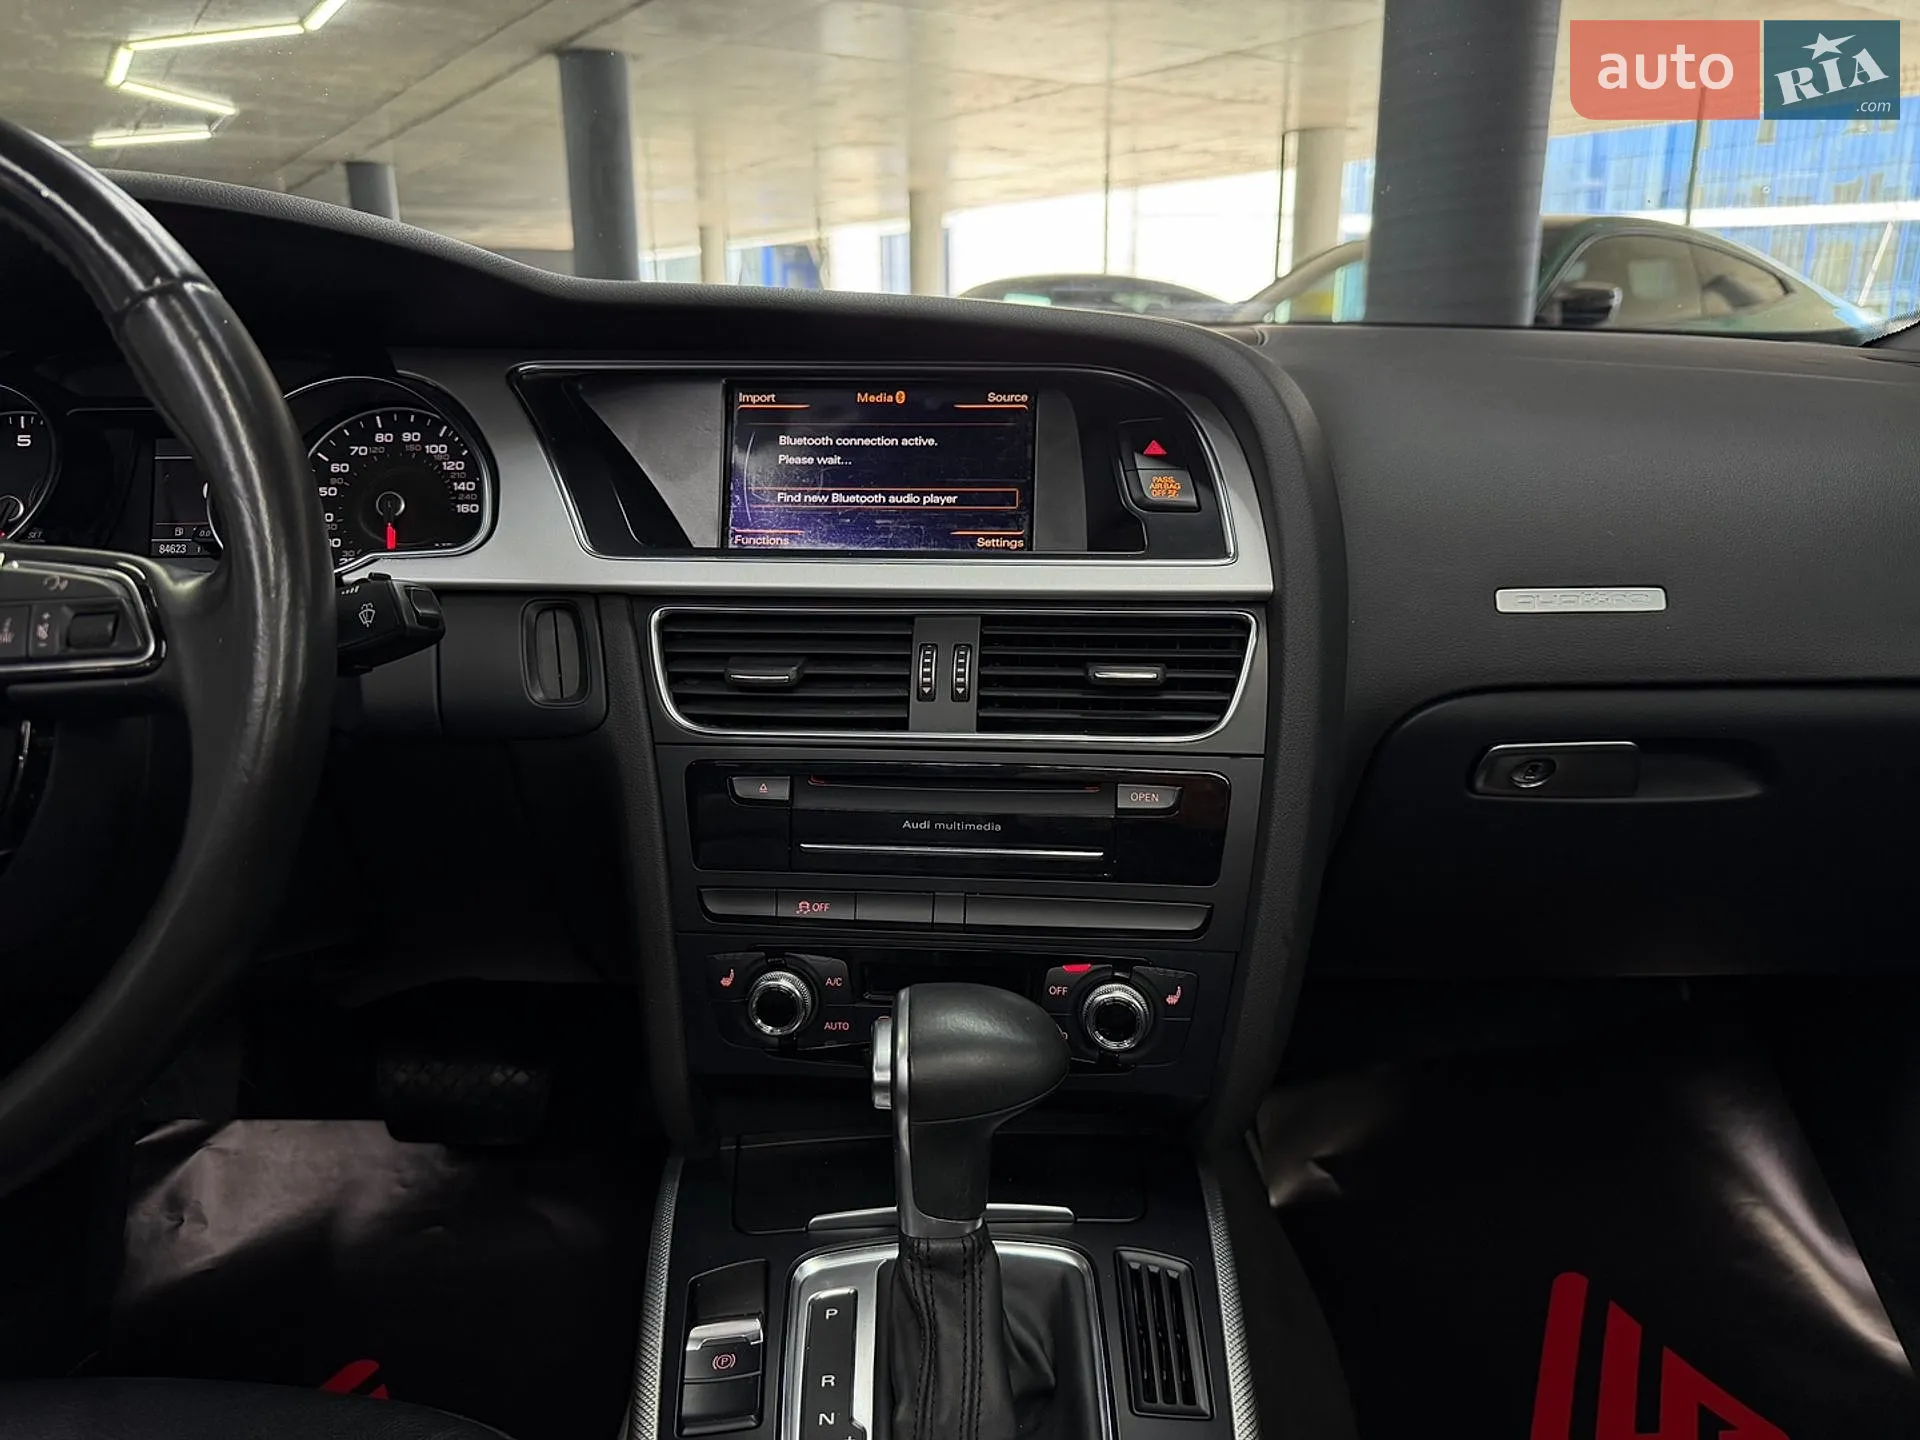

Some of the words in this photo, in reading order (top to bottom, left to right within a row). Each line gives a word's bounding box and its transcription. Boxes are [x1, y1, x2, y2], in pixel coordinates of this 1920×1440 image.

[738, 392, 776, 404] Import
[856, 393, 894, 403] Media
[987, 392, 1028, 402] Source
[16, 434, 31, 447] 5
[375, 433, 393, 443] 80
[402, 432, 421, 442] 90
[779, 435, 833, 446] Bluetooth
[836, 436, 898, 446] connection
[901, 436, 938, 446] active.
[350, 445, 368, 456] 70
[425, 444, 448, 454] 100
[778, 454, 814, 465] Please
[816, 454, 852, 466] wait...
[330, 463, 349, 473] 60
[442, 461, 465, 470] 120
[453, 481, 476, 491] 140
[318, 487, 337, 497] 50
[777, 493, 801, 503] Find
[804, 495, 828, 504] new
[831, 493, 886, 504] Bluetooth
[888, 494, 920, 504] audio
[922, 494, 958, 507] player
[456, 504, 480, 513] 160
[733, 535, 790, 547] Functions
[976, 537, 1024, 549] Settings
[159, 544, 187, 554] 84623
[1130, 791, 1159, 803] OPEN
[902, 819, 931, 831] Audi
[934, 820, 1002, 832] multimedia
[812, 902, 830, 912] OFF
[825, 976, 843, 988] A/C
[1049, 985, 1068, 995] OFF
[824, 1021, 850, 1031] AUTO
[825, 1309, 838, 1320] P
[821, 1375, 836, 1387] R
[818, 1412, 835, 1425] N
